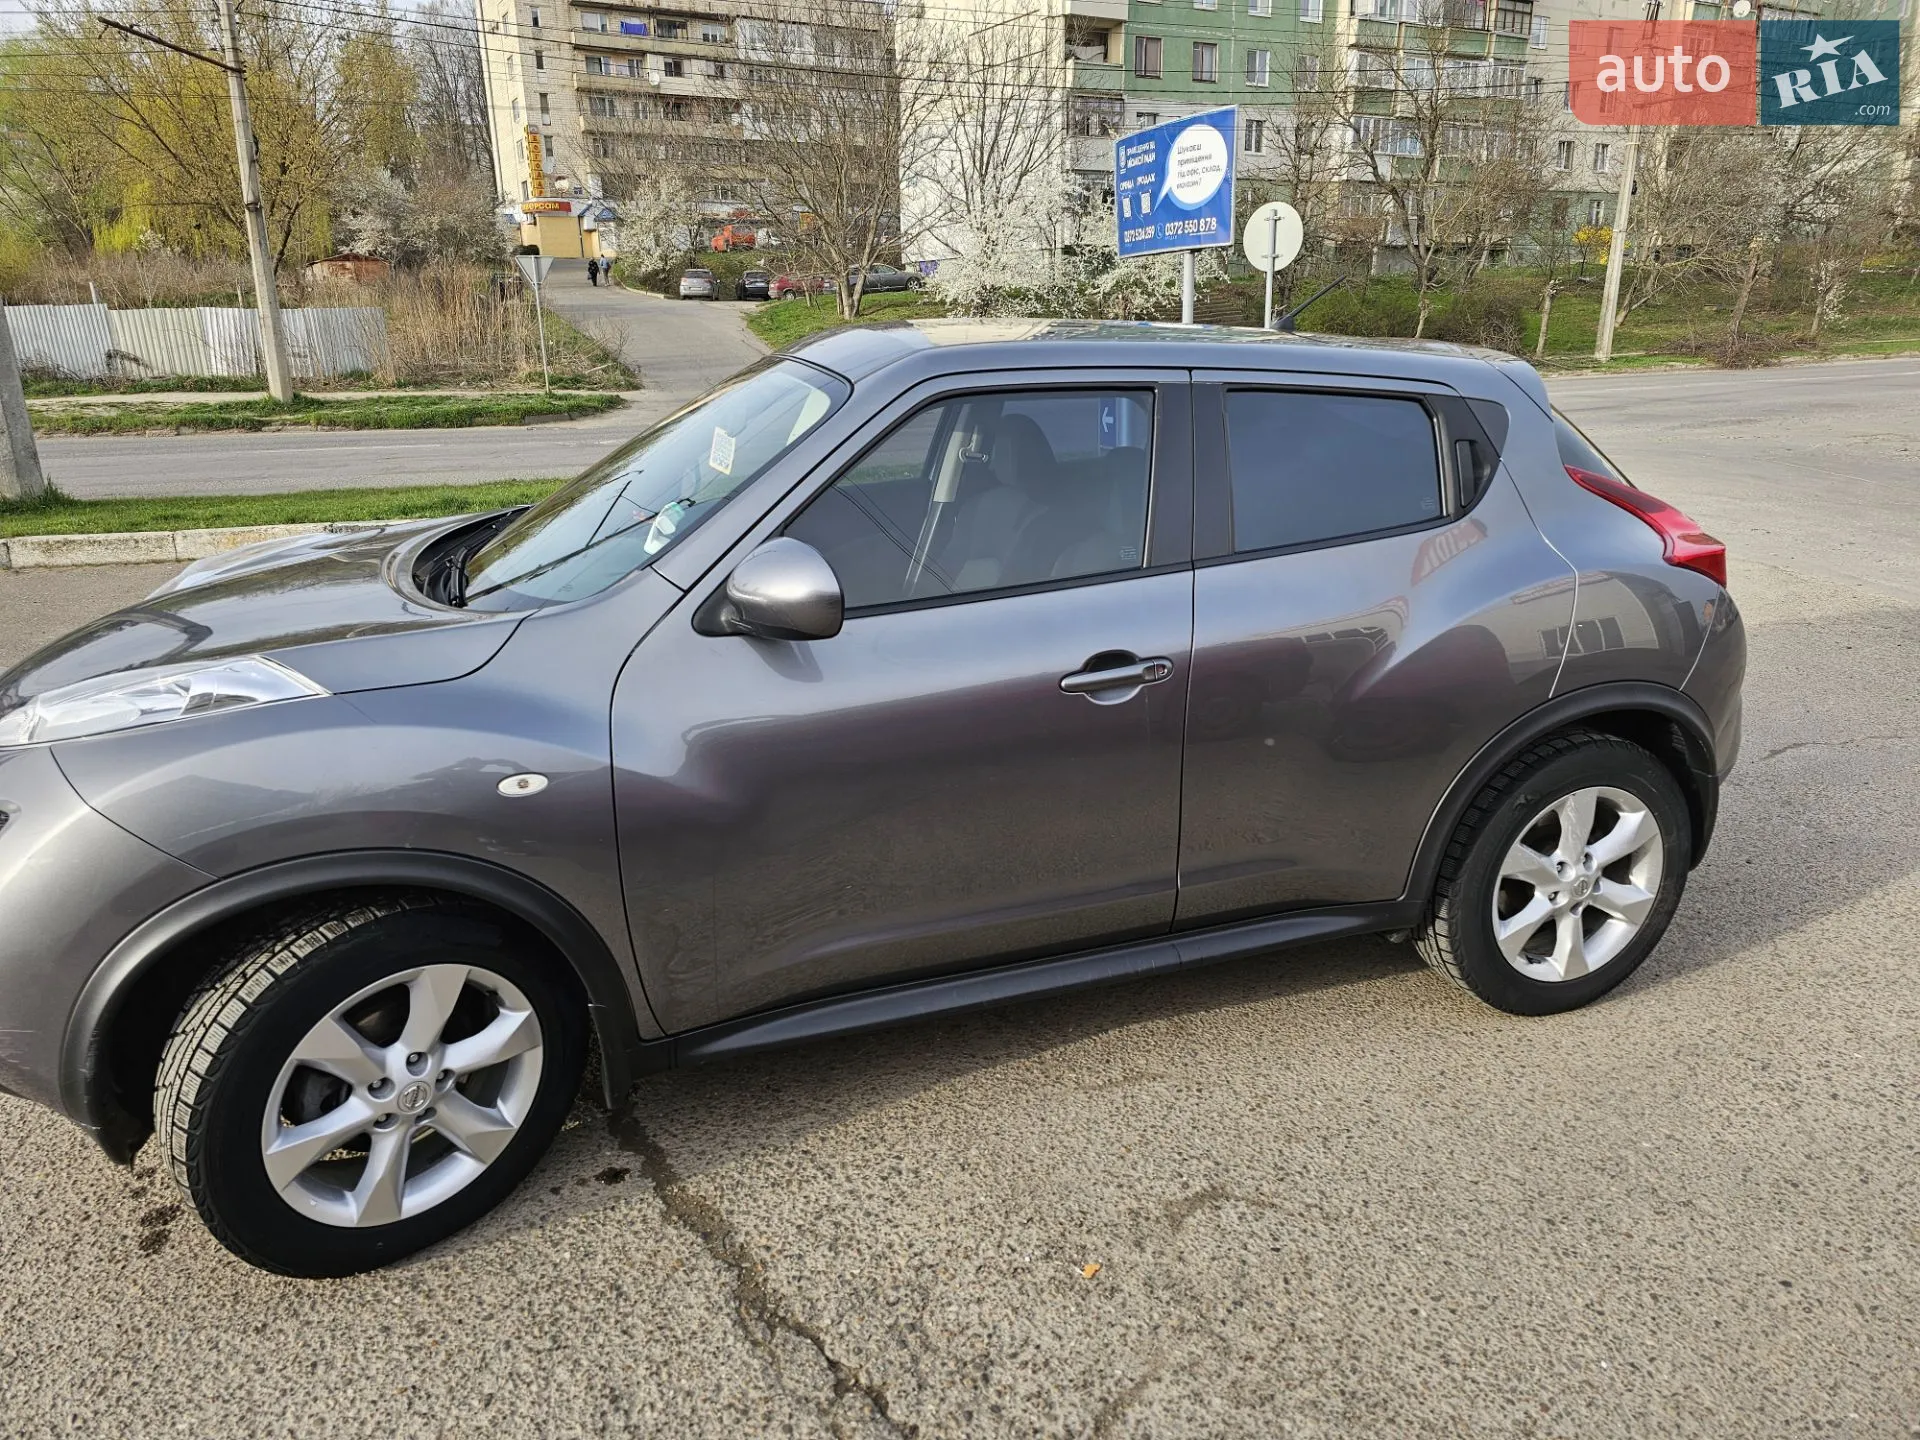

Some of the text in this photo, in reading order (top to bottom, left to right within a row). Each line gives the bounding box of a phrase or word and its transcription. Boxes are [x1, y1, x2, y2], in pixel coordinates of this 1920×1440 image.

[1165, 217, 1217, 236] 0372 550 878
